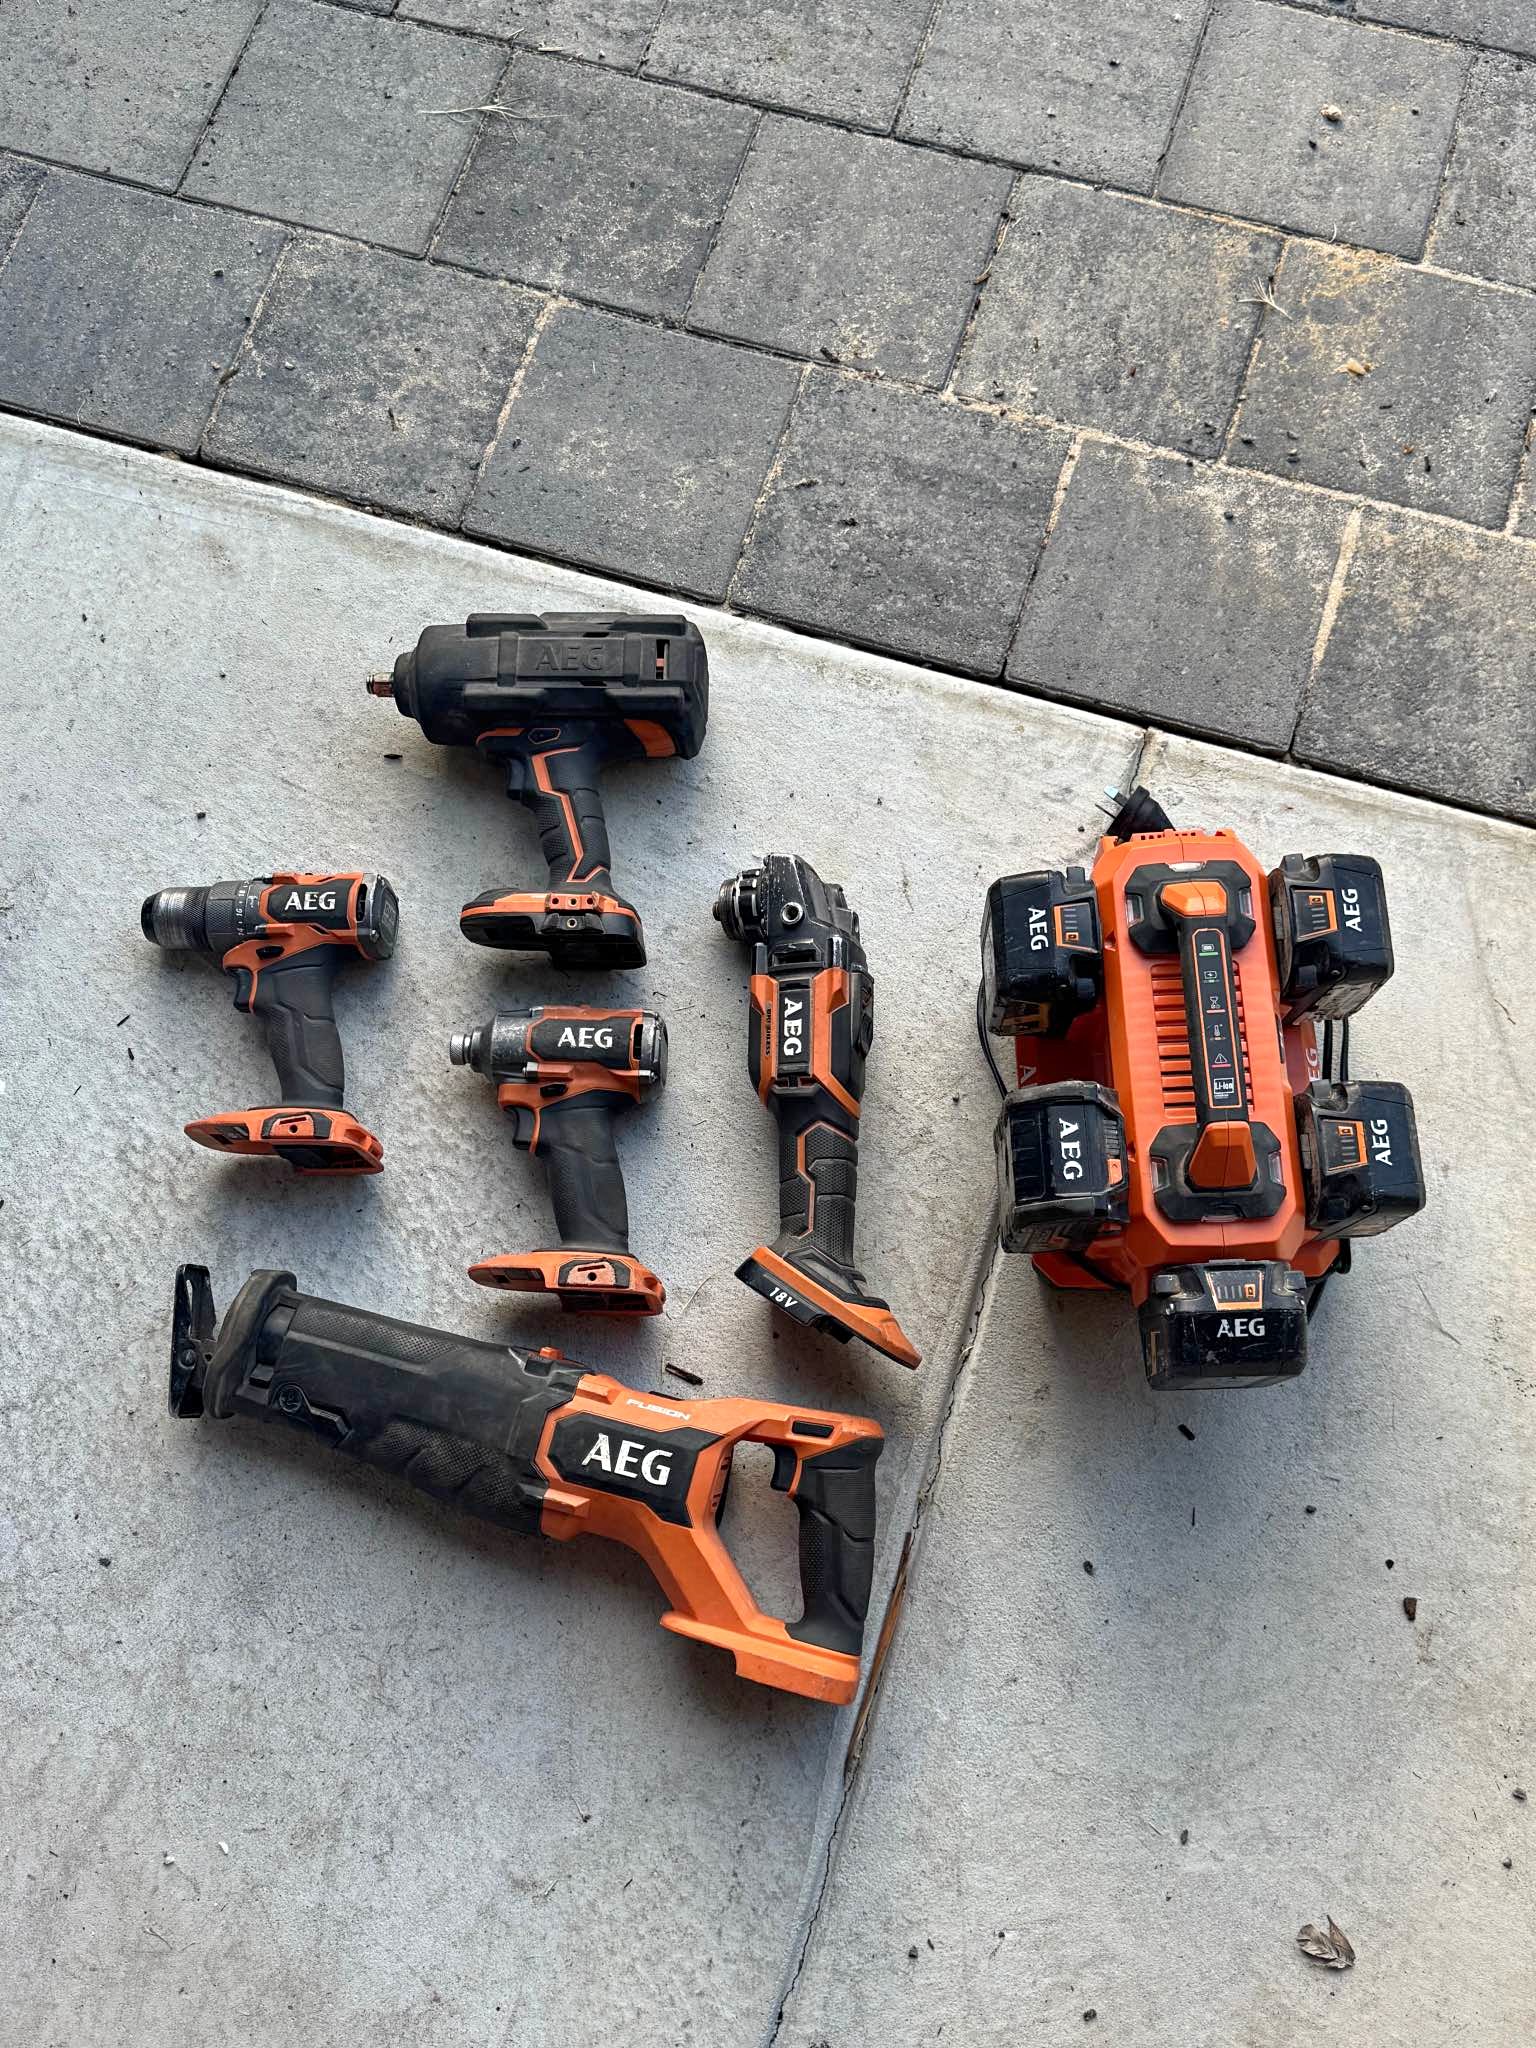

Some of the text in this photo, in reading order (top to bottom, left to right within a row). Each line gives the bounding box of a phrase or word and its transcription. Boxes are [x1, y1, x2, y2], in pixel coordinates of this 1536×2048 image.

[535, 643, 604, 671] AEG
[284, 891, 336, 911] AEG
[1342, 888, 1362, 932] AEG
[1027, 907, 1049, 951] AEG
[557, 1026, 613, 1049] AEG
[784, 997, 803, 1056] AEG
[1305, 1047, 1320, 1081] EG
[1059, 1117, 1083, 1180] AEG
[1370, 1119, 1393, 1166] AEG
[769, 1286, 799, 1308] 18V
[1216, 1317, 1266, 1338] AEG
[626, 1398, 691, 1421] FUSION
[581, 1432, 674, 1486] AEG
